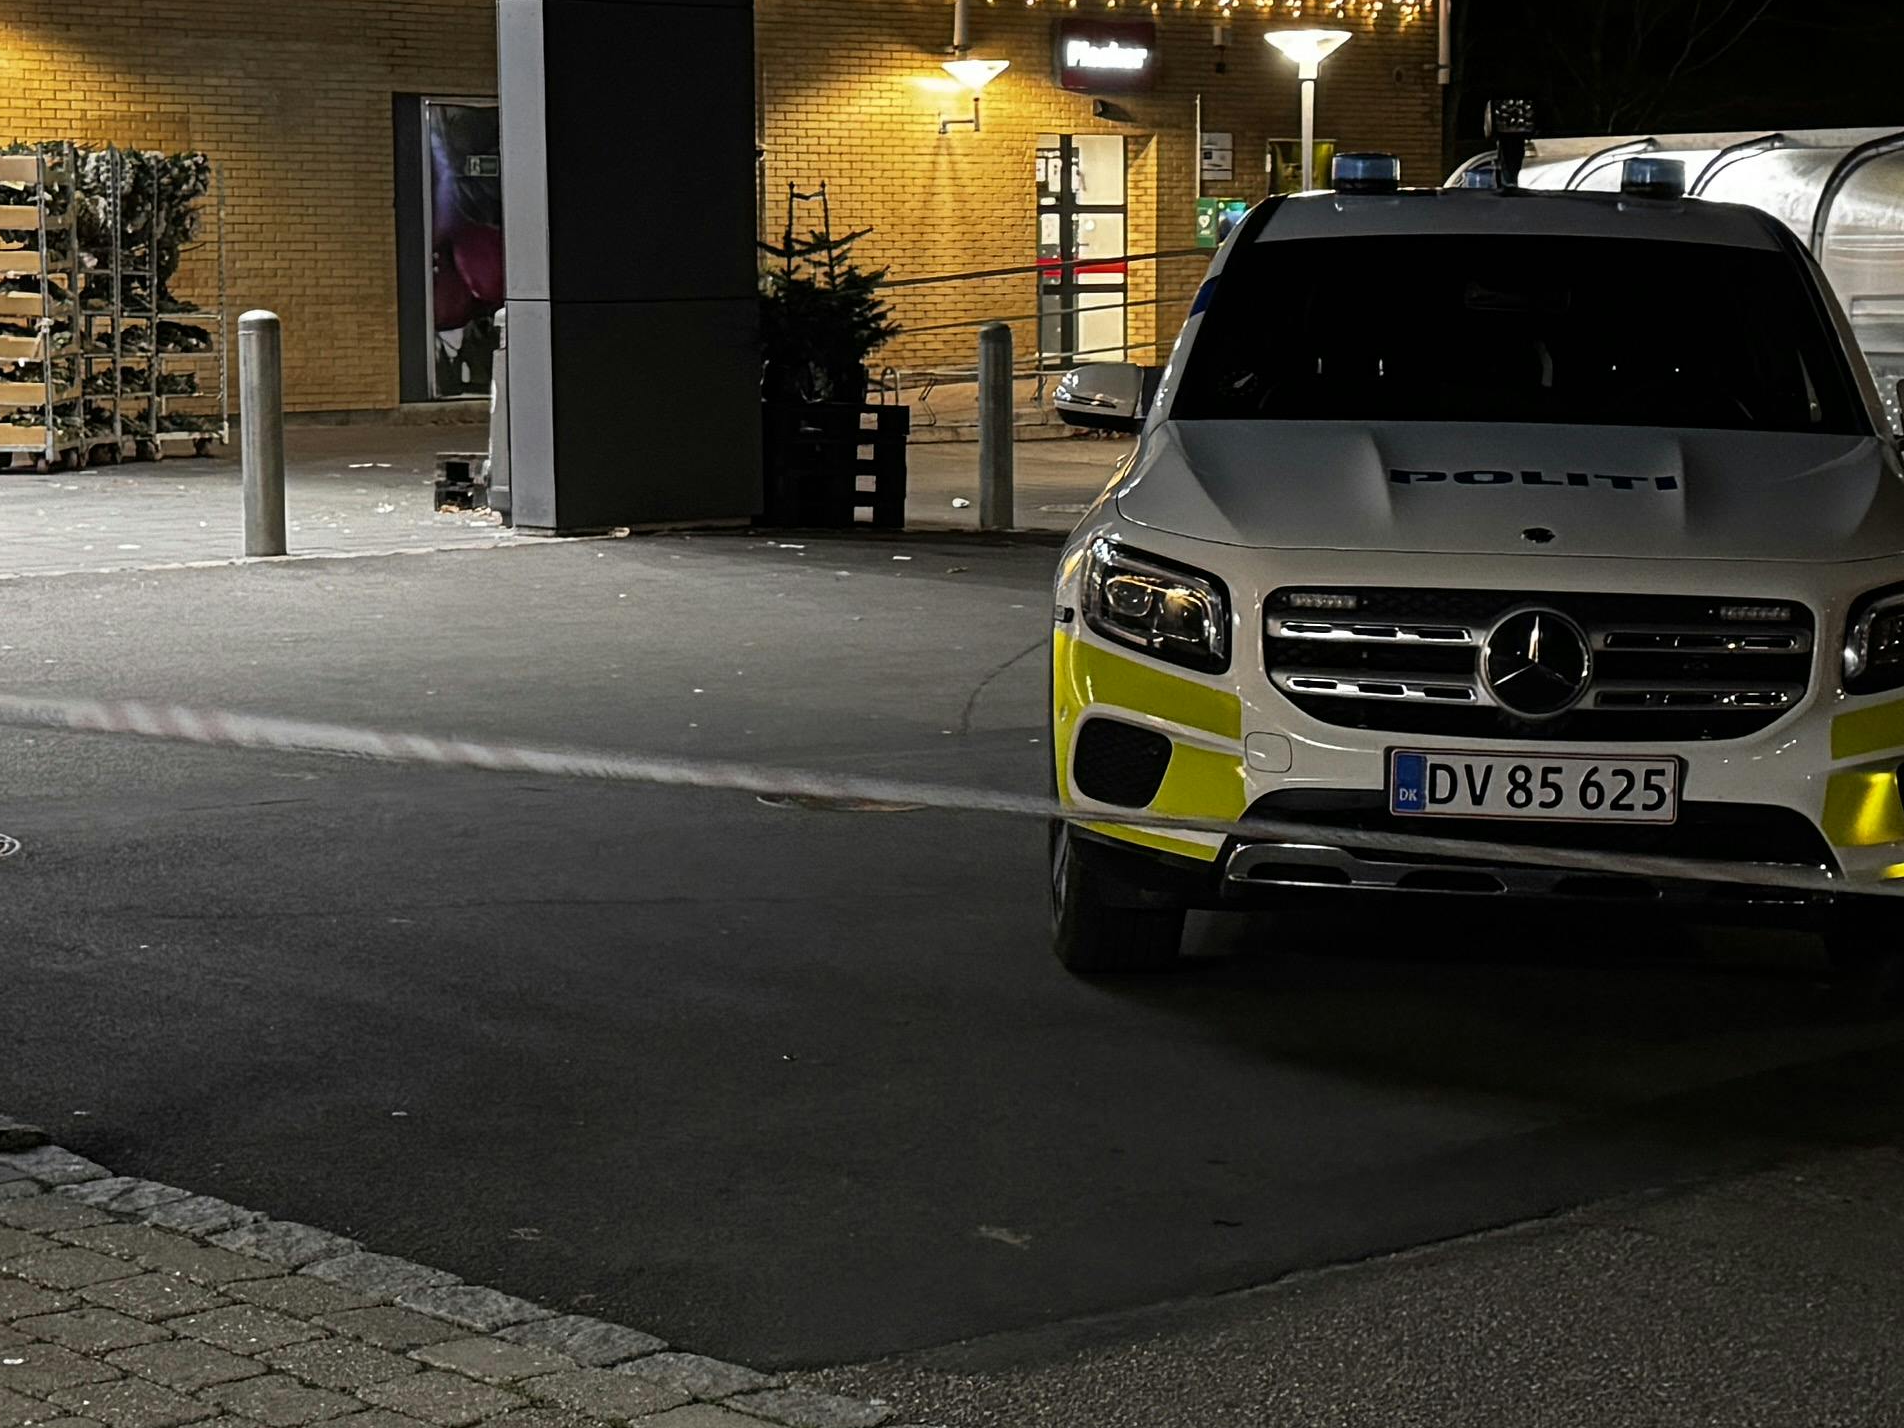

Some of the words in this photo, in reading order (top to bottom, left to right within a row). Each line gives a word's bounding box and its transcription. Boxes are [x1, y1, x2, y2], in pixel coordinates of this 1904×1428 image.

[1390, 469, 1678, 490] POLITI
[1399, 788, 1418, 803] DK
[1428, 763, 1493, 806] DV
[1505, 764, 1564, 810] 85
[1578, 766, 1668, 812] 625
